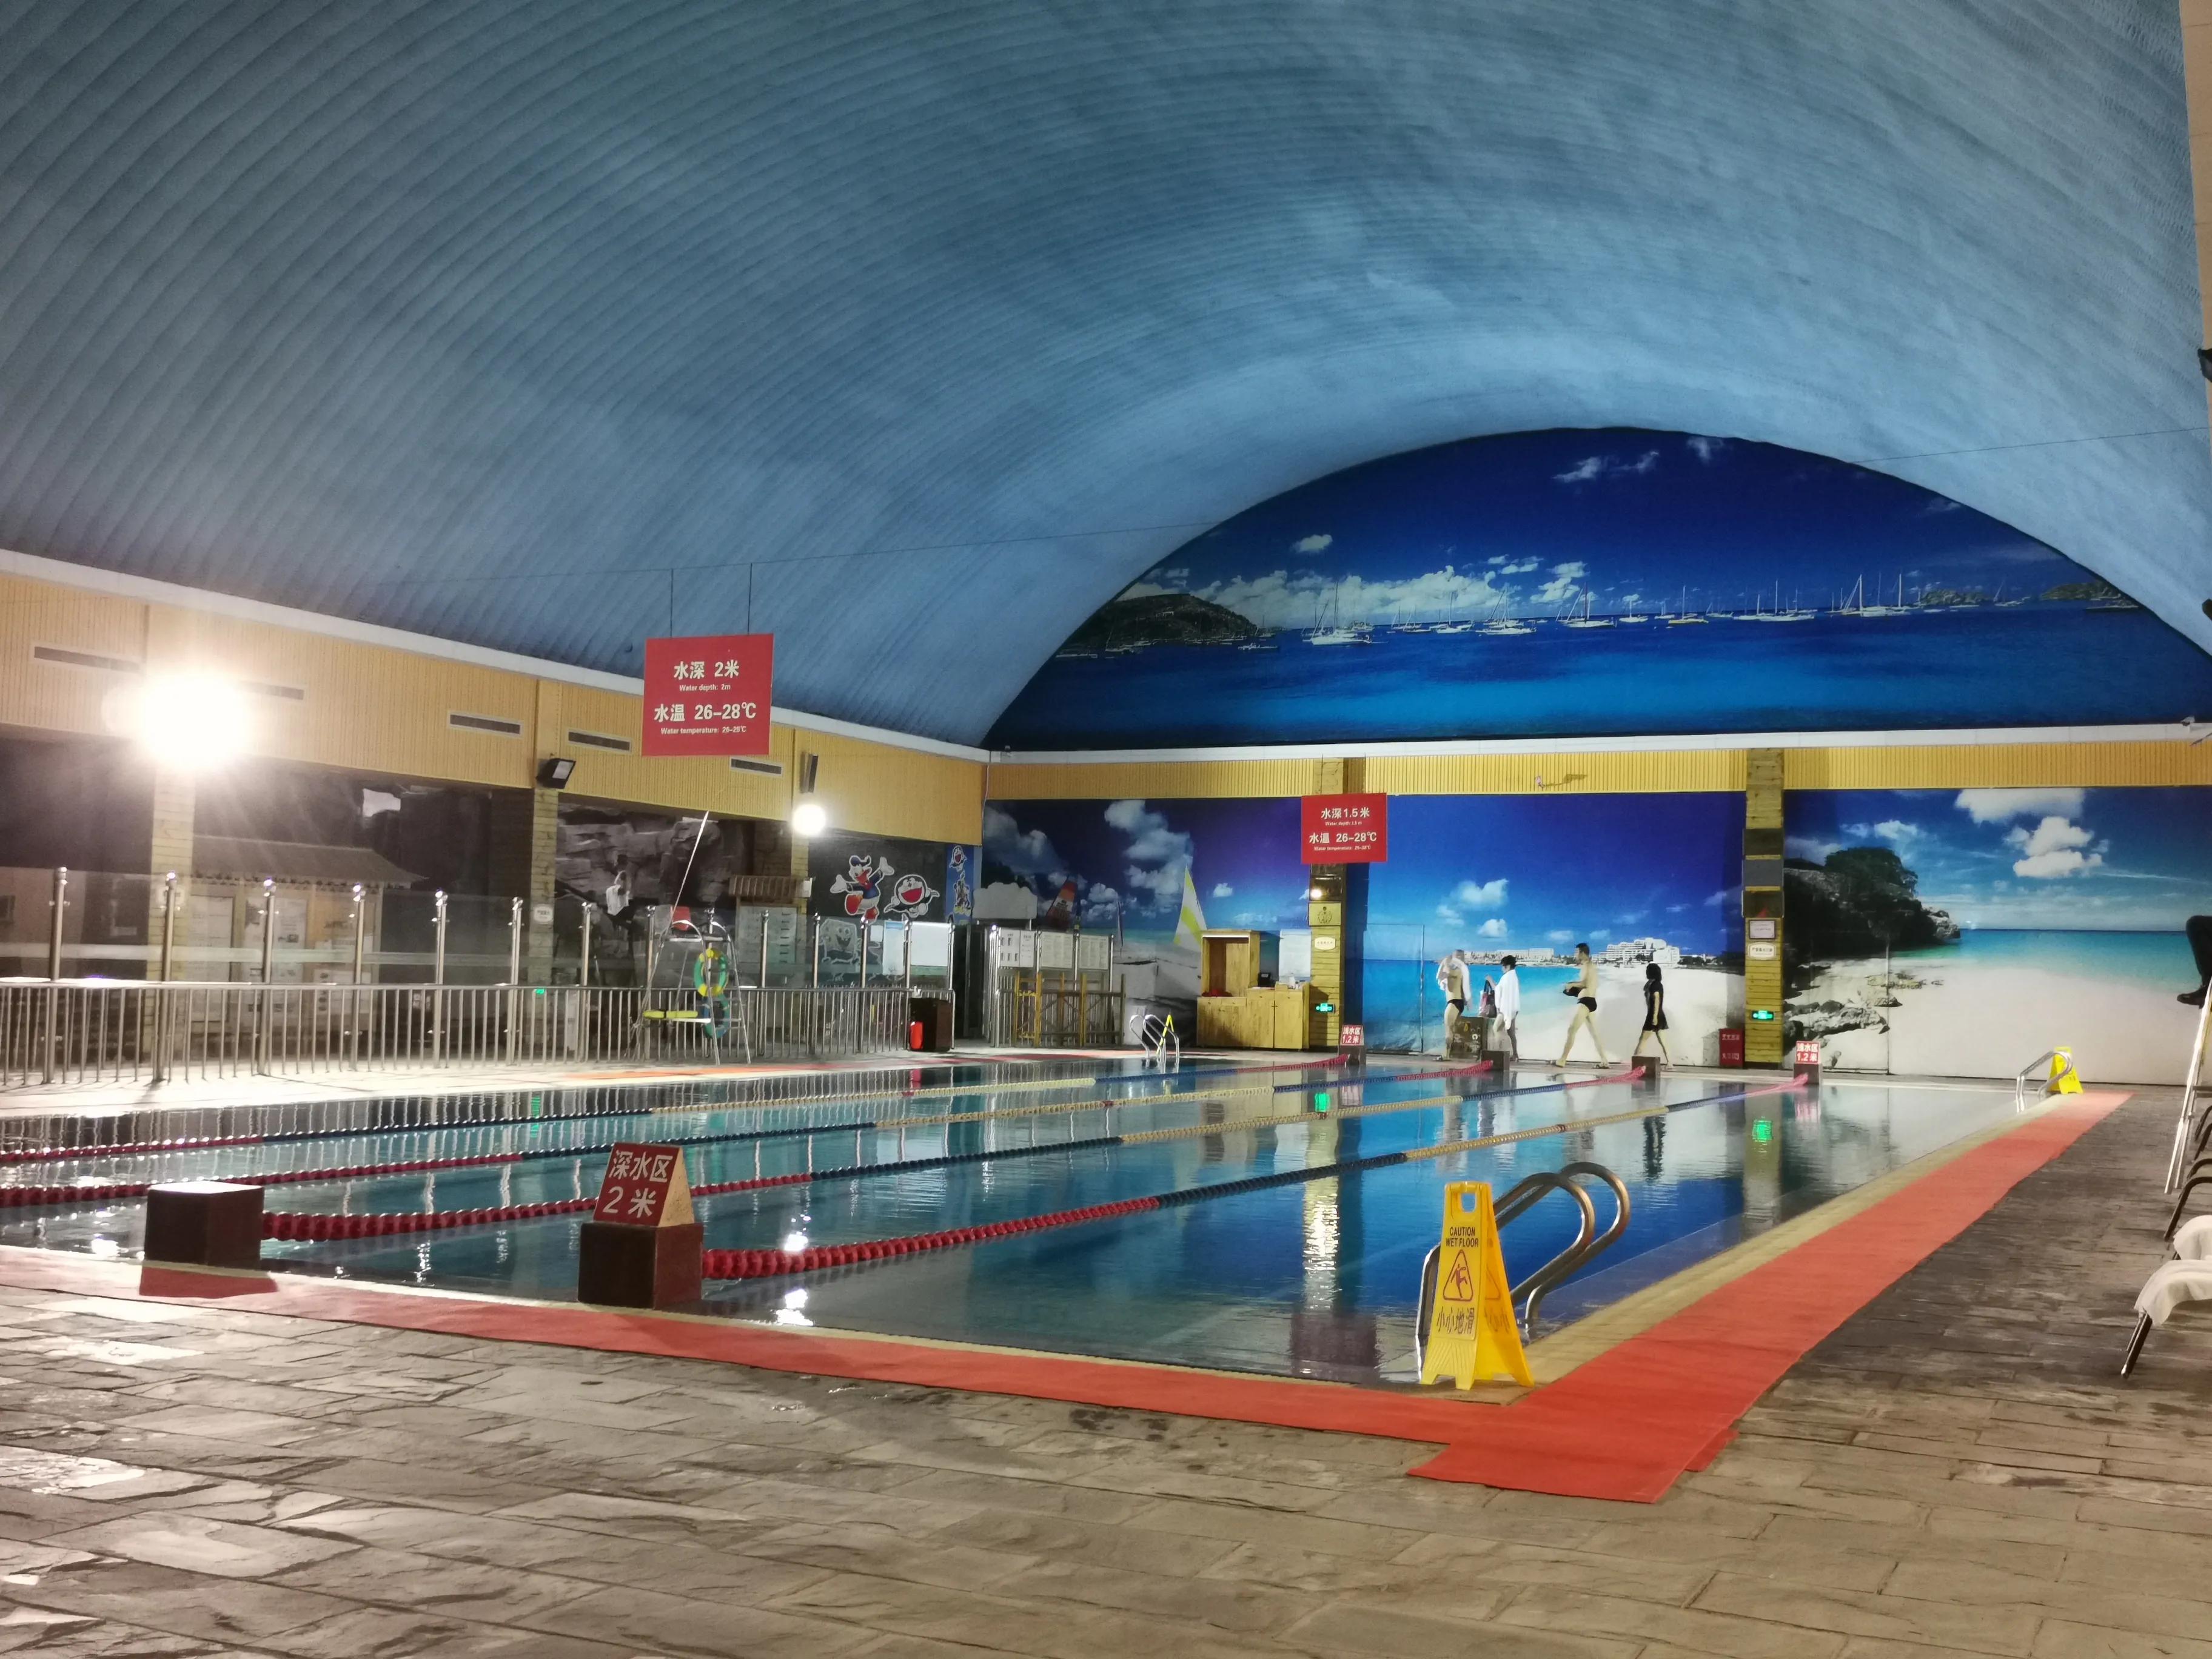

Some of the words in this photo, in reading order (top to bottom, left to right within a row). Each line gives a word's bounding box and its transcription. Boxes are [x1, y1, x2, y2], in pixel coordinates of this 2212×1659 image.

[674, 661, 705, 680] 水深
[714, 660, 739, 678] 2米
[699, 683, 718, 692] depth:
[654, 703, 685, 722] 水温
[1309, 832, 1330, 844] 水温
[609, 1149, 673, 1182] 深水区
[602, 1186, 656, 1218] 2米
[1450, 1227, 1475, 1236] CAUTION
[1446, 1238, 1458, 1247] WET
[1459, 1238, 1479, 1247] FLOOR
[1436, 1306, 1474, 1335] 小心地滑
